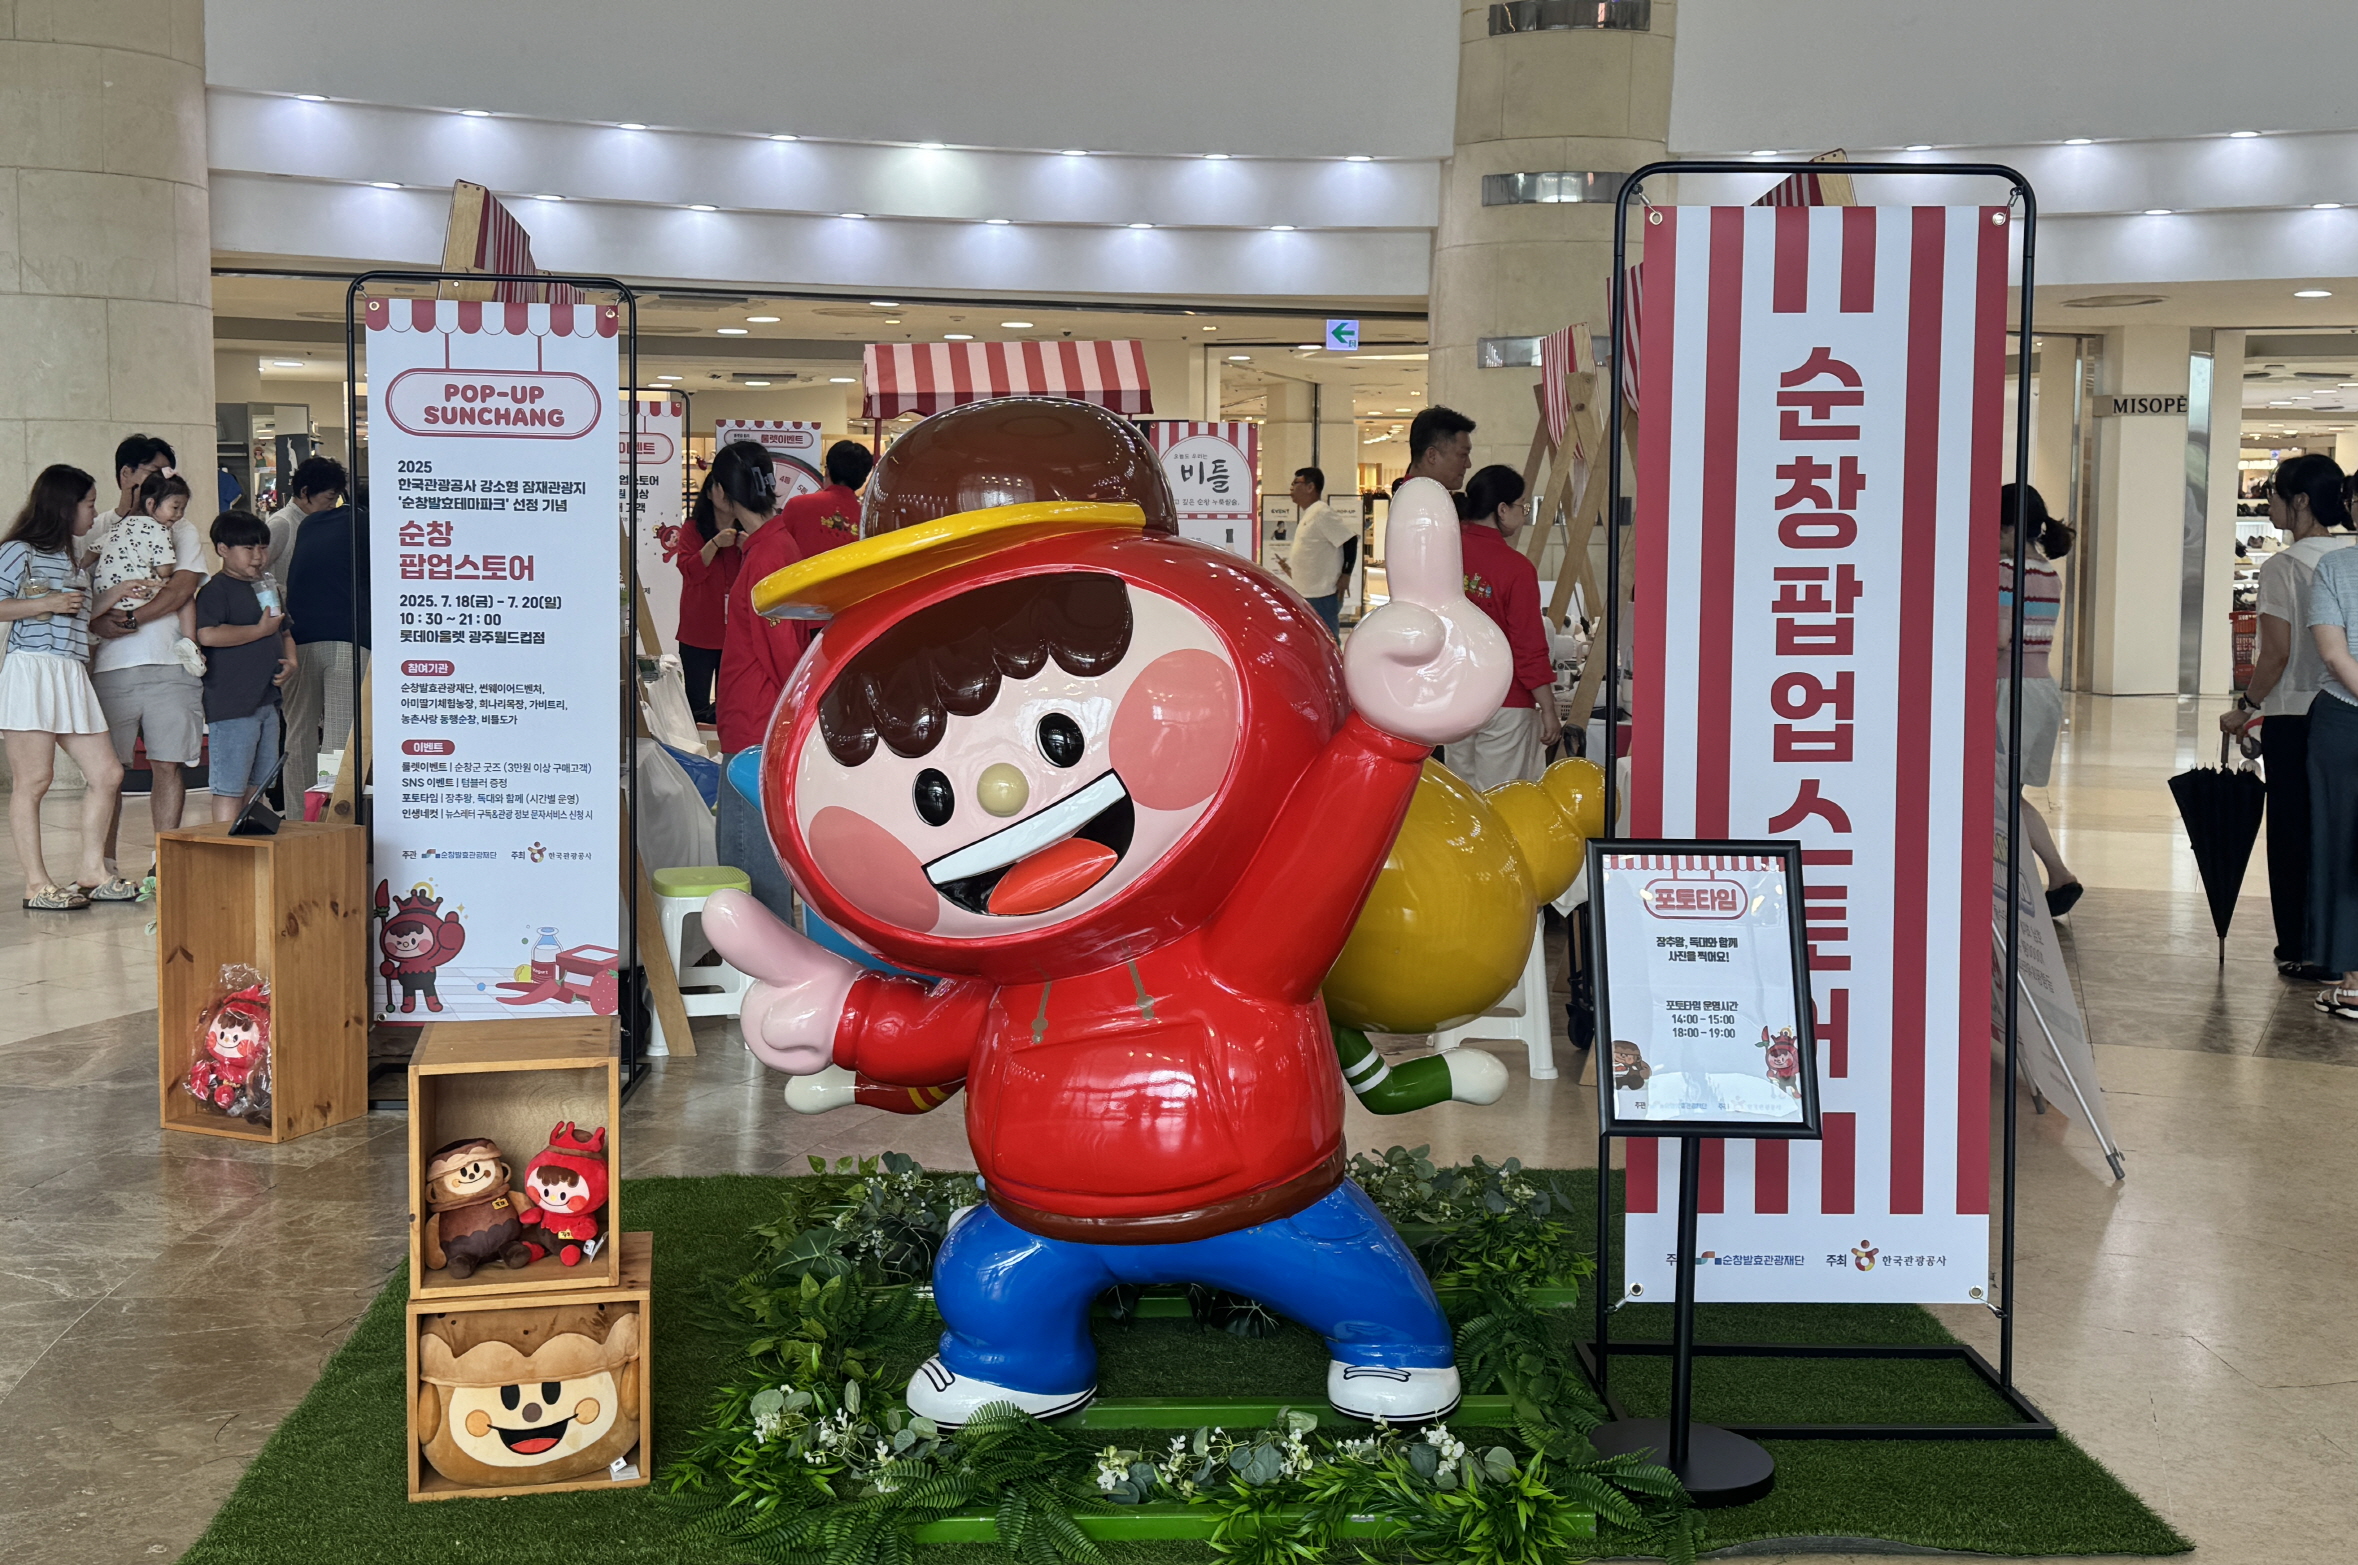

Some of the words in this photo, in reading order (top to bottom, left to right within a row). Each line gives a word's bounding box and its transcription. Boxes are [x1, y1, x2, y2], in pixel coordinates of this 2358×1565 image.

[445, 384, 544, 404] POP-UP
[424, 406, 564, 427] SUNCHANG
[761, 434, 803, 444] 룰렛이벤트
[398, 460, 432, 473] 2025
[1180, 459, 1230, 493] 비틀
[398, 478, 476, 492] 한국관광공사
[480, 480, 518, 493] 강소형
[523, 481, 585, 494] 잠재관광지
[399, 496, 509, 510] '순창발효테마파크'
[513, 499, 538, 511] 선정
[542, 499, 567, 512] 기념
[399, 520, 453, 547] 순창
[400, 554, 534, 581] 팝업스토어
[400, 594, 437, 607] 2025.
[441, 595, 451, 607] 7.
[456, 595, 493, 608] 18(금)
[508, 596, 518, 608] 7.
[522, 596, 561, 609] 20(일)
[400, 612, 414, 625] 10
[426, 613, 442, 625] 30
[459, 613, 472, 625] 21
[484, 614, 501, 625] 00
[400, 630, 465, 643] 롯데아울렛
[469, 631, 545, 644] 광주월드컵점
[407, 663, 449, 674] 참여기관
[401, 683, 477, 694] 순창발효관광재단,
[401, 698, 477, 709] 아미딸기체험농장,
[529, 700, 567, 710] 가비트리,
[401, 714, 438, 724] 농촌사랑
[440, 715, 479, 725] 동행순창,
[482, 715, 518, 725] 비틀도가
[413, 742, 444, 753] 이벤트
[402, 762, 447, 772] 룰렛이벤트
[455, 762, 481, 772] 순창군
[483, 763, 501, 772] 굿즈
[504, 762, 531, 773] (3만원
[534, 763, 551, 773] 이상
[553, 763, 591, 774] 구매고객)
[402, 778, 424, 787] SNS
[427, 778, 454, 787] 이벤트
[461, 778, 487, 788] 텀블러
[490, 778, 507, 788] 증정
[402, 793, 438, 803] 포토타임
[477, 794, 503, 803] 독대와
[506, 794, 523, 803] 함께
[526, 793, 555, 804] (시간별
[558, 794, 579, 805] 운영)
[402, 809, 438, 819] 인생네컷
[445, 809, 475, 819] 뉴스레터
[477, 809, 513, 819] 구독&관광
[515, 810, 529, 819] 정보
[531, 810, 567, 820] 문자서비스
[569, 810, 584, 820] 신청
[585, 810, 592, 820] 시
[402, 851, 416, 859] 주관
[441, 851, 497, 859] 순창발효관광재단
[511, 851, 525, 859] 주최
[549, 852, 591, 860] 한국관광공사
[1655, 888, 1738, 911] 포토타임
[1656, 936, 1688, 949] 장추왕,
[1689, 937, 1718, 948] 독대와
[1717, 937, 1738, 948] 함께
[1669, 951, 1696, 961] 사진을
[1698, 951, 1729, 962] 찍어요!
[1666, 1001, 1701, 1011] 포토타임
[1703, 1001, 1739, 1011] 운영시간
[1672, 1014, 1698, 1024] 14:00
[1708, 1015, 1734, 1024] 15:00
[1673, 1028, 1699, 1037] 18:00
[1709, 1028, 1735, 1038] 19:00
[1665, 1253, 1678, 1267] 주
[1722, 1255, 1804, 1265] 순창발효관광재단
[1826, 1254, 1846, 1267] 주최
[1882, 1256, 1946, 1266] 한국관광공사
